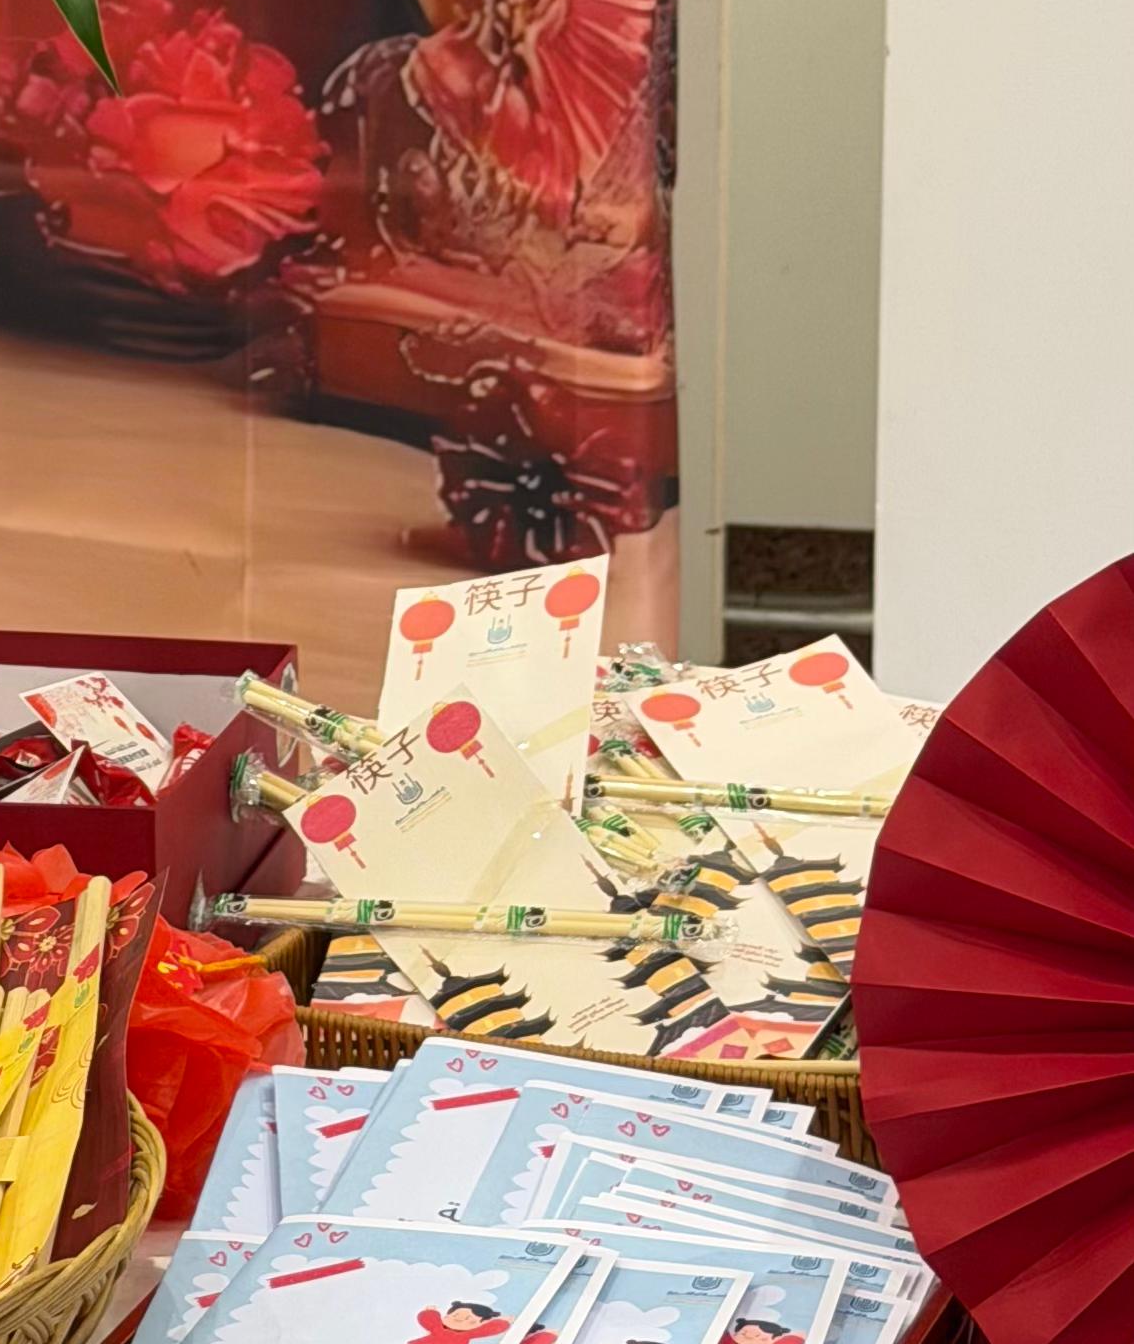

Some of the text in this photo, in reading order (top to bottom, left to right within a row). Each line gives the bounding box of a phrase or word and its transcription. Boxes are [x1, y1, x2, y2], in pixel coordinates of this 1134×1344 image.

[464, 573, 546, 617] 筷子
[696, 662, 783, 700] 筷子
[898, 700, 938, 731] 筷
[345, 726, 421, 795] 筷子
